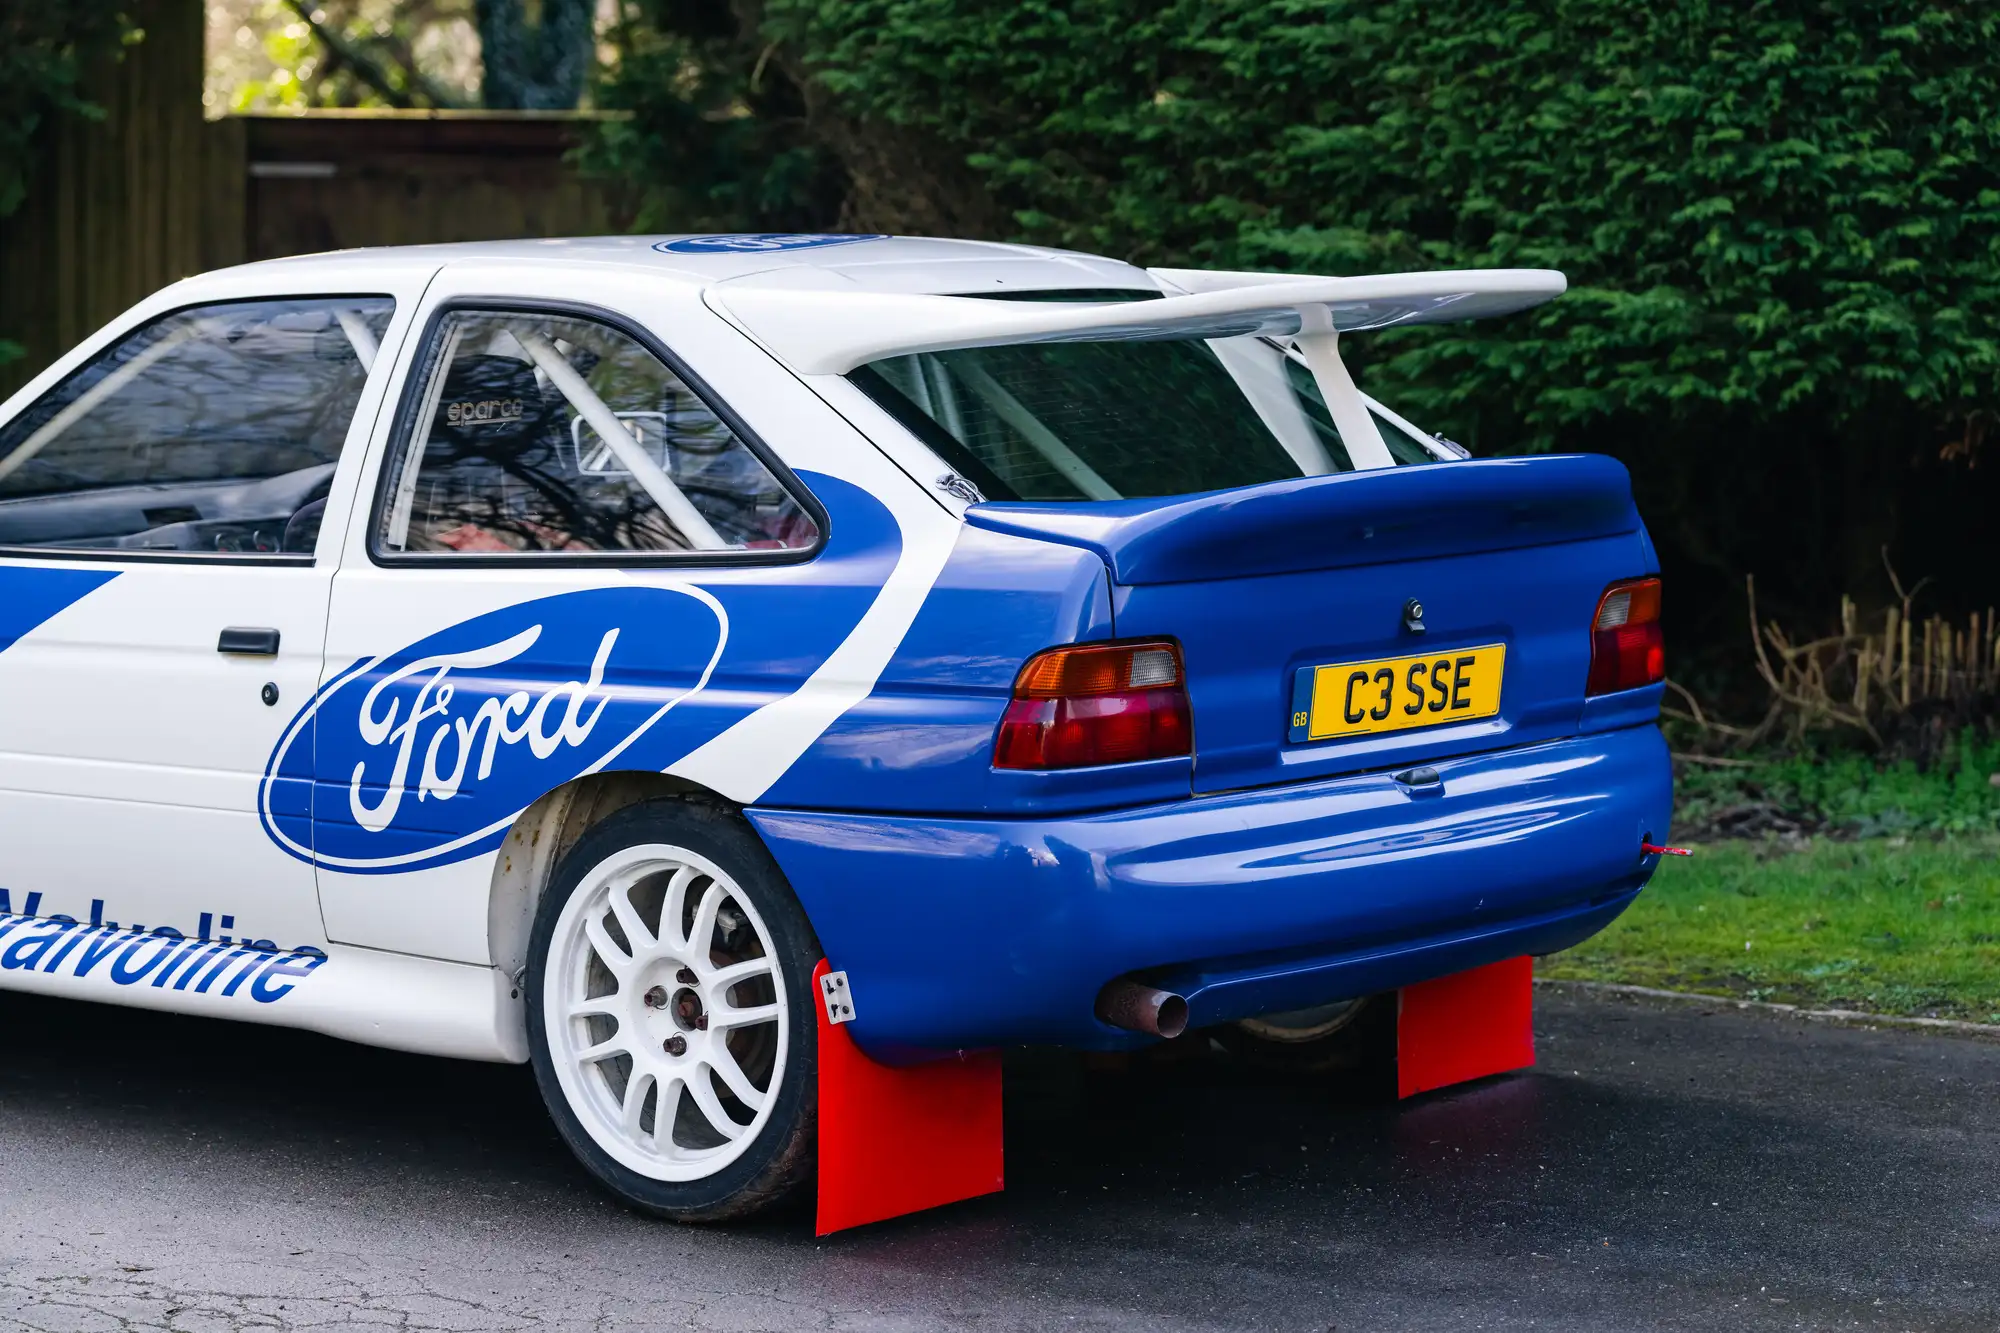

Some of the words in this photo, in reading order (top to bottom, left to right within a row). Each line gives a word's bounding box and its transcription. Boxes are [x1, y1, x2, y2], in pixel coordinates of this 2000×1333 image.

[447, 398, 523, 426] sparco
[1344, 668, 1394, 724] C3
[1403, 656, 1475, 716] SSE
[349, 624, 620, 832] Ford
[1293, 711, 1307, 727] GB
